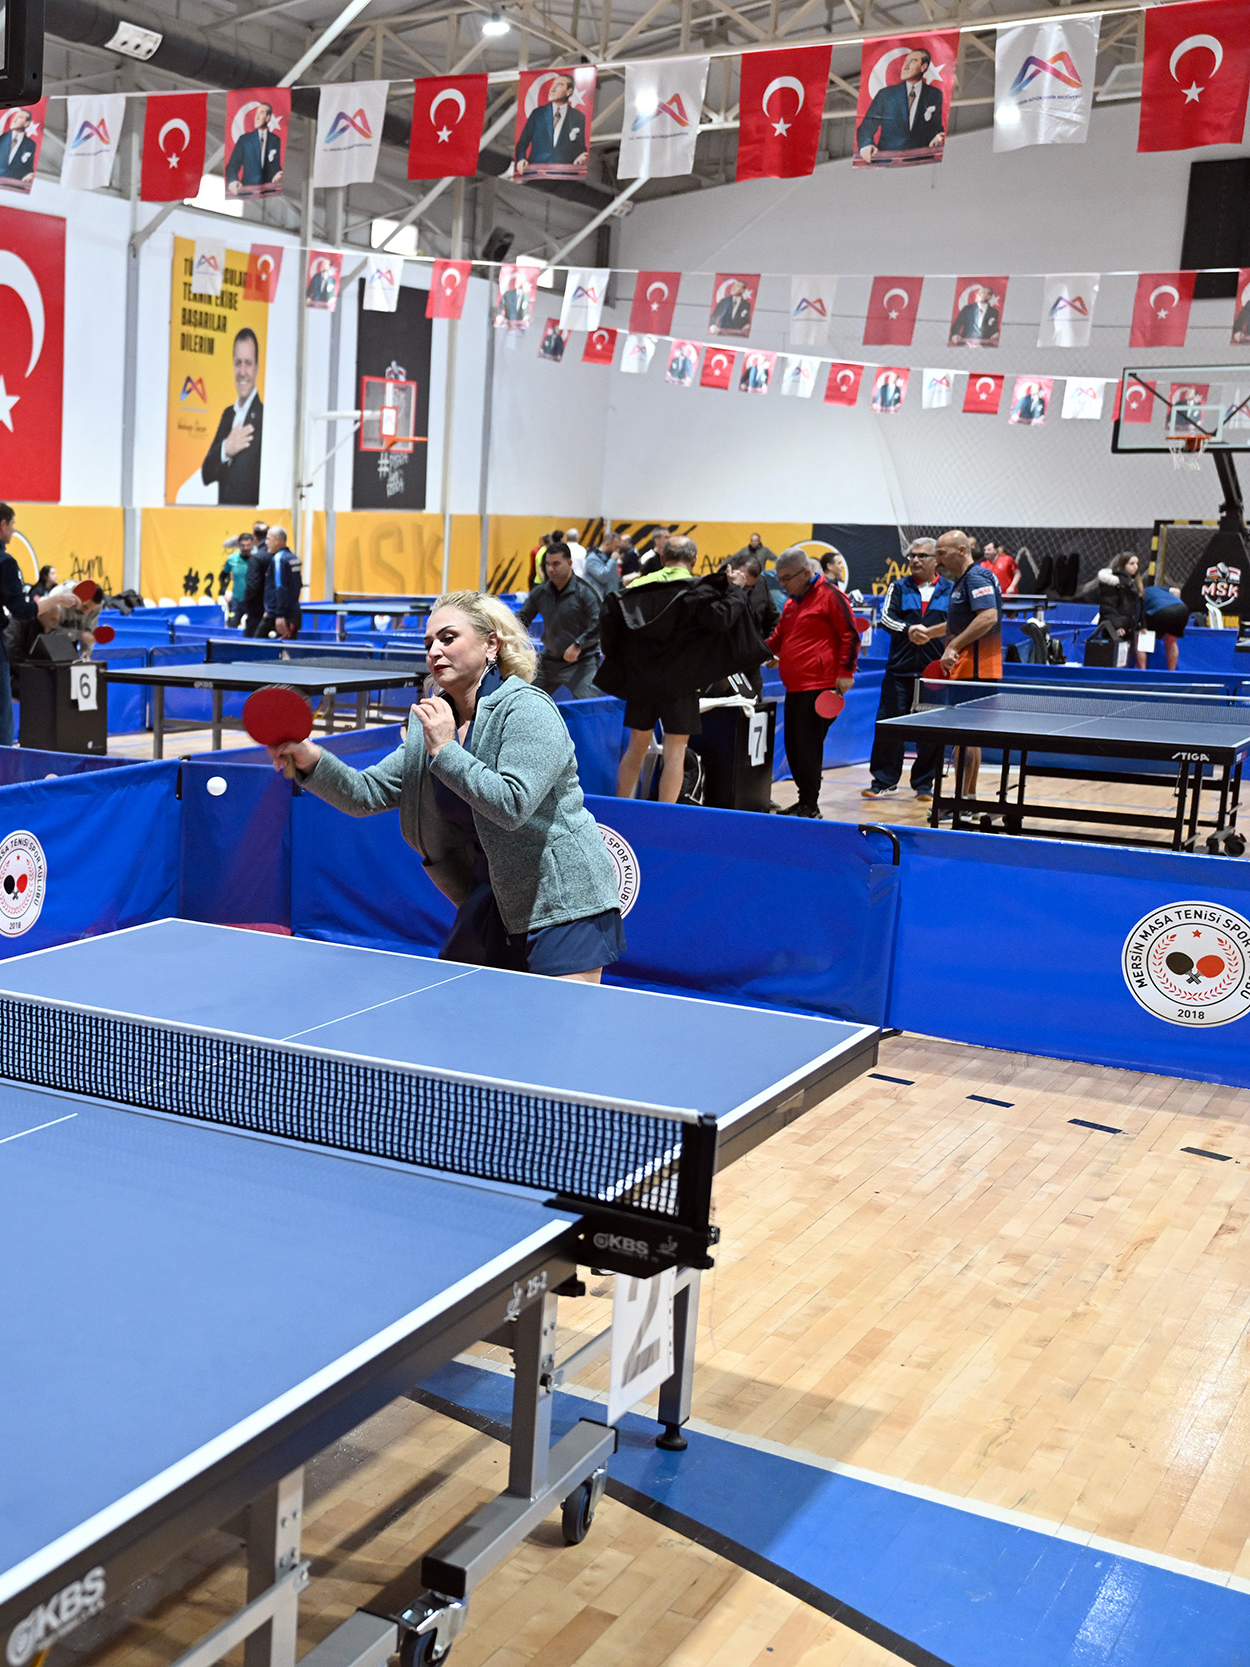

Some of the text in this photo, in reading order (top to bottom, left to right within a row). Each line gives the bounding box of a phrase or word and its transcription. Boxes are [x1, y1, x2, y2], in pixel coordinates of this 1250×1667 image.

[1201, 582, 1239, 598] MSK
[79, 672, 91, 699] 6
[753, 725, 763, 758] 7
[1171, 752, 1210, 762] STIGA
[28, 842, 41, 864] SPOR
[607, 837, 629, 863] SPOR
[9, 922, 22, 930] 2018
[1129, 942, 1148, 989] MERSİN
[1139, 915, 1173, 941] MASA
[1177, 1008, 1205, 1020] 2018
[609, 1233, 649, 1255] KBS
[34, 1565, 107, 1641] KBS
